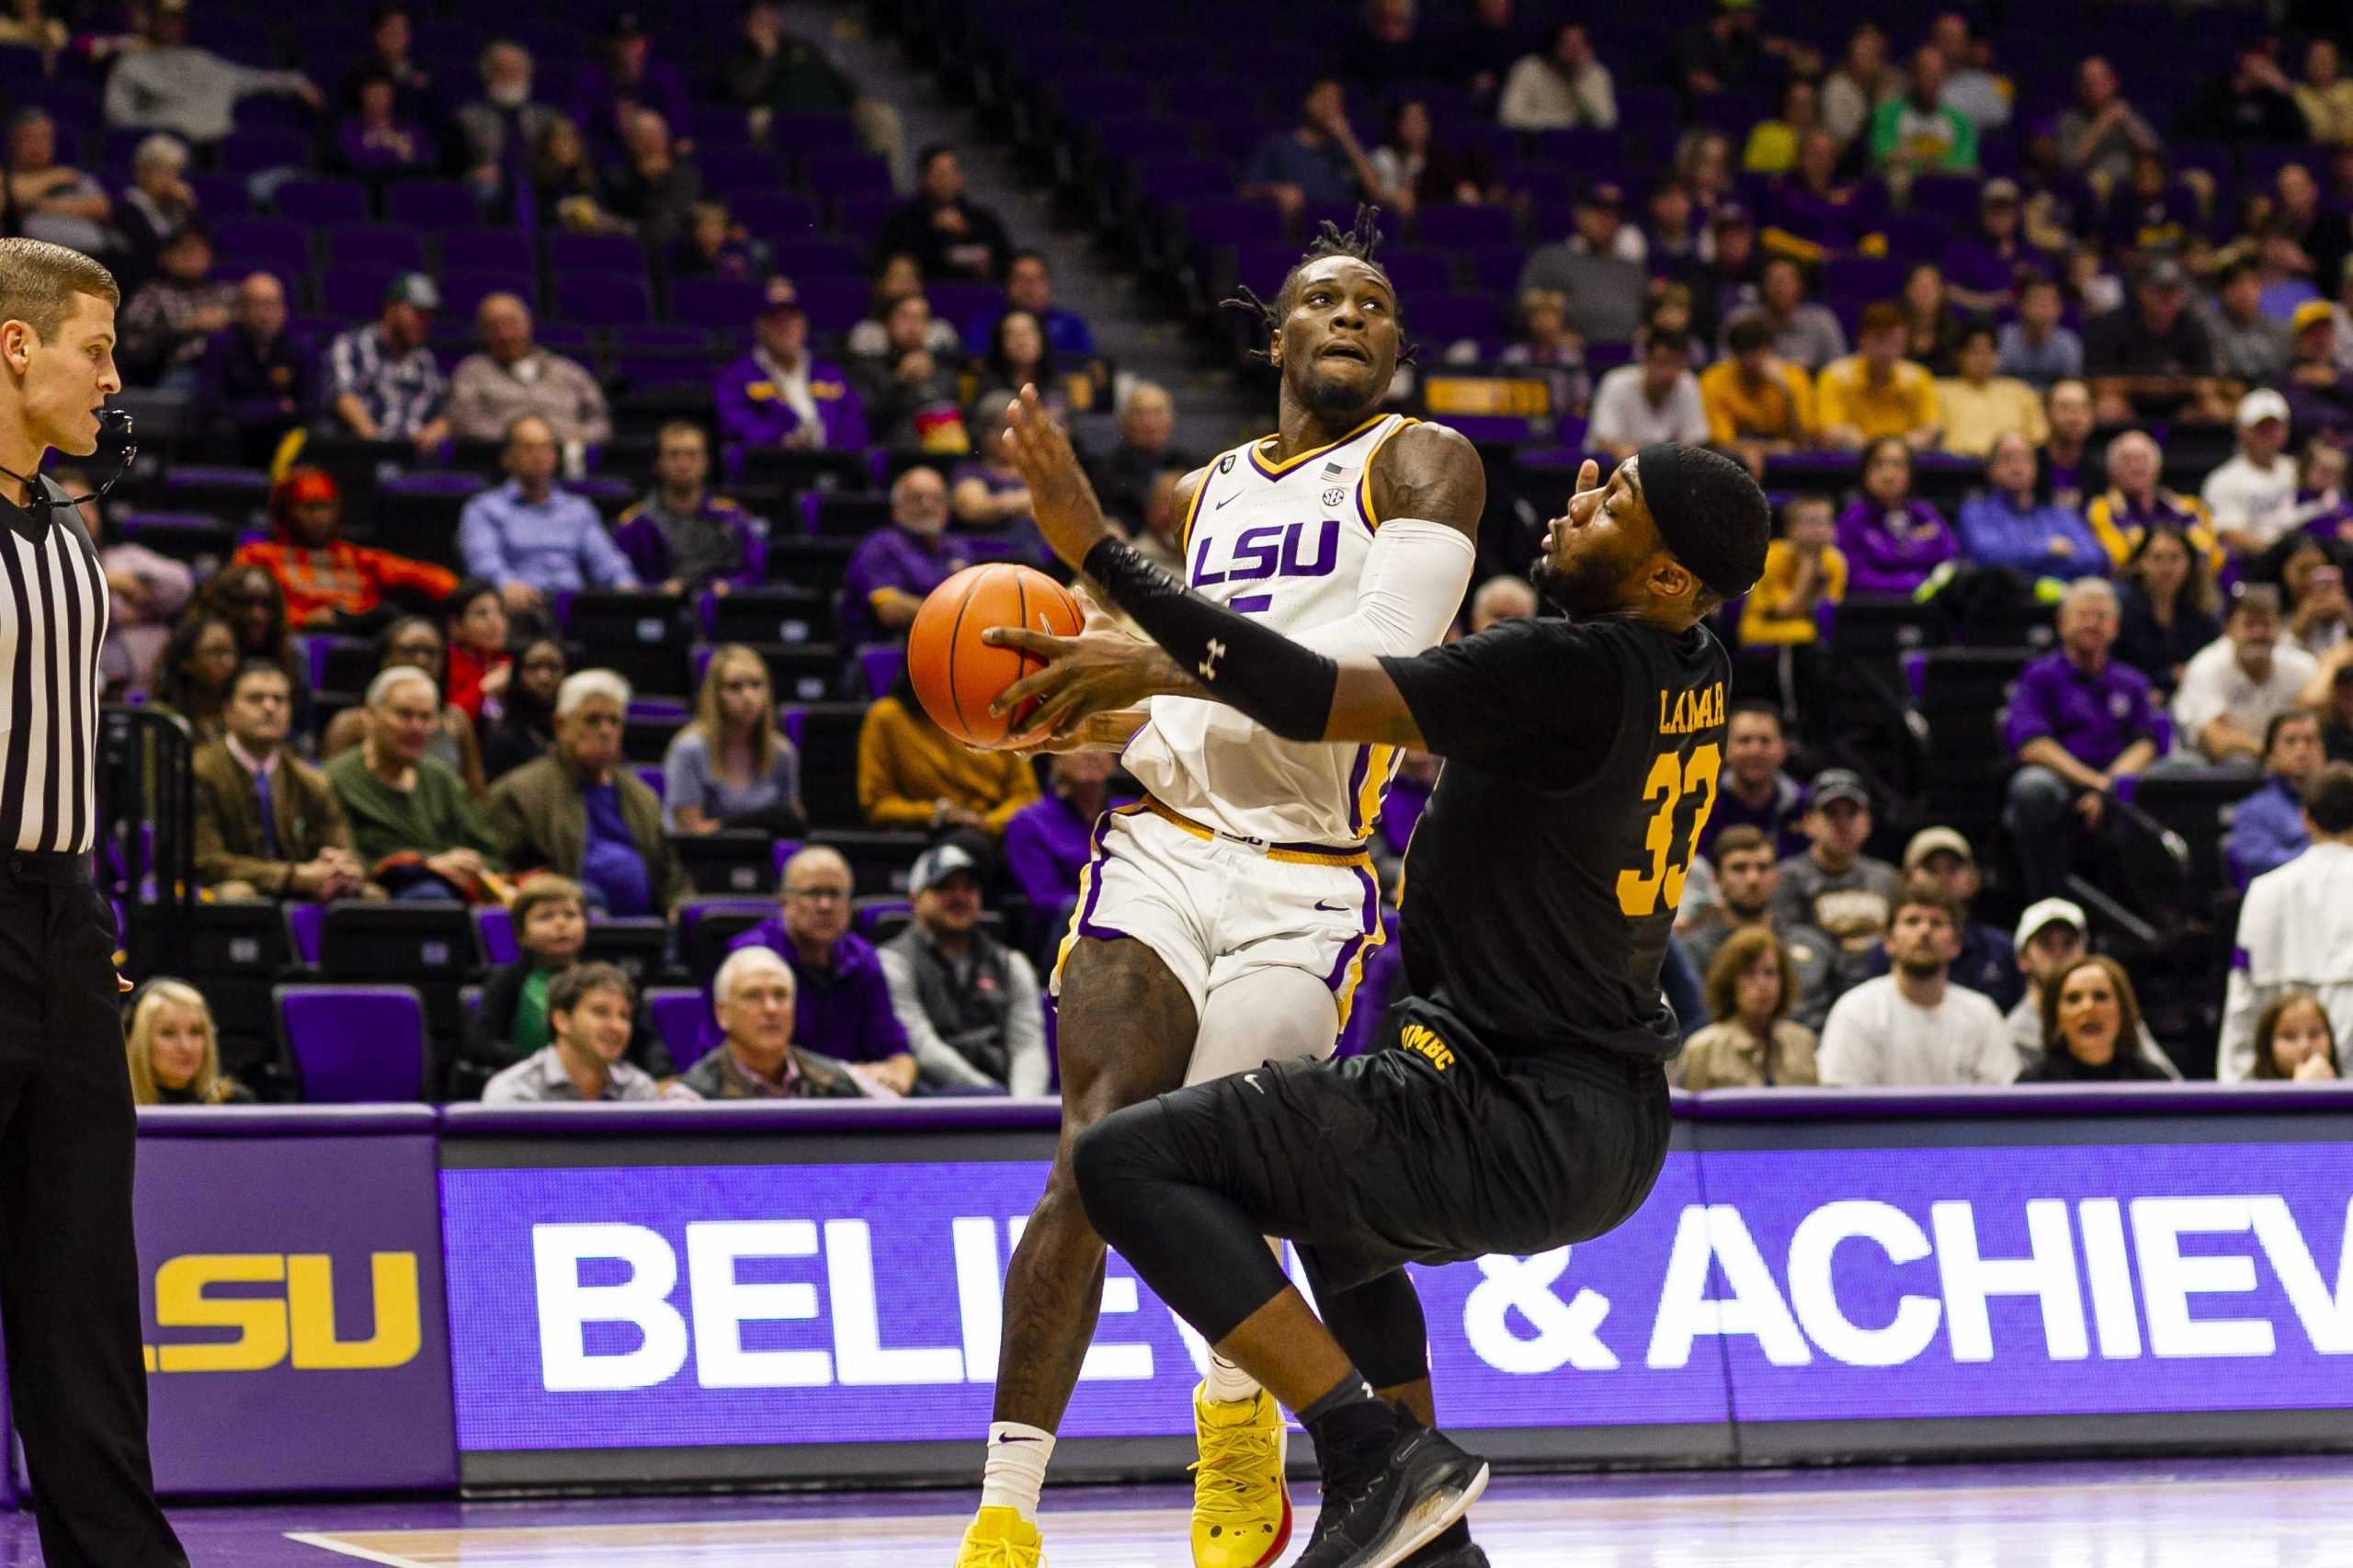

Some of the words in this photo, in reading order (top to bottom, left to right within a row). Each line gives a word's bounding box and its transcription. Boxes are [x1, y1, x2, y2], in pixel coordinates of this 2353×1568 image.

[1192, 520, 1340, 588] LSU
[1659, 681, 1725, 733] LAMAR
[1616, 743, 1721, 916] 33
[1401, 1024, 1455, 1071] UMBC
[143, 1251, 421, 1373] SU
[532, 1216, 1432, 1393] BELI
[1463, 1245, 1621, 1374] &
[1645, 1193, 2353, 1369] ACHIEV
